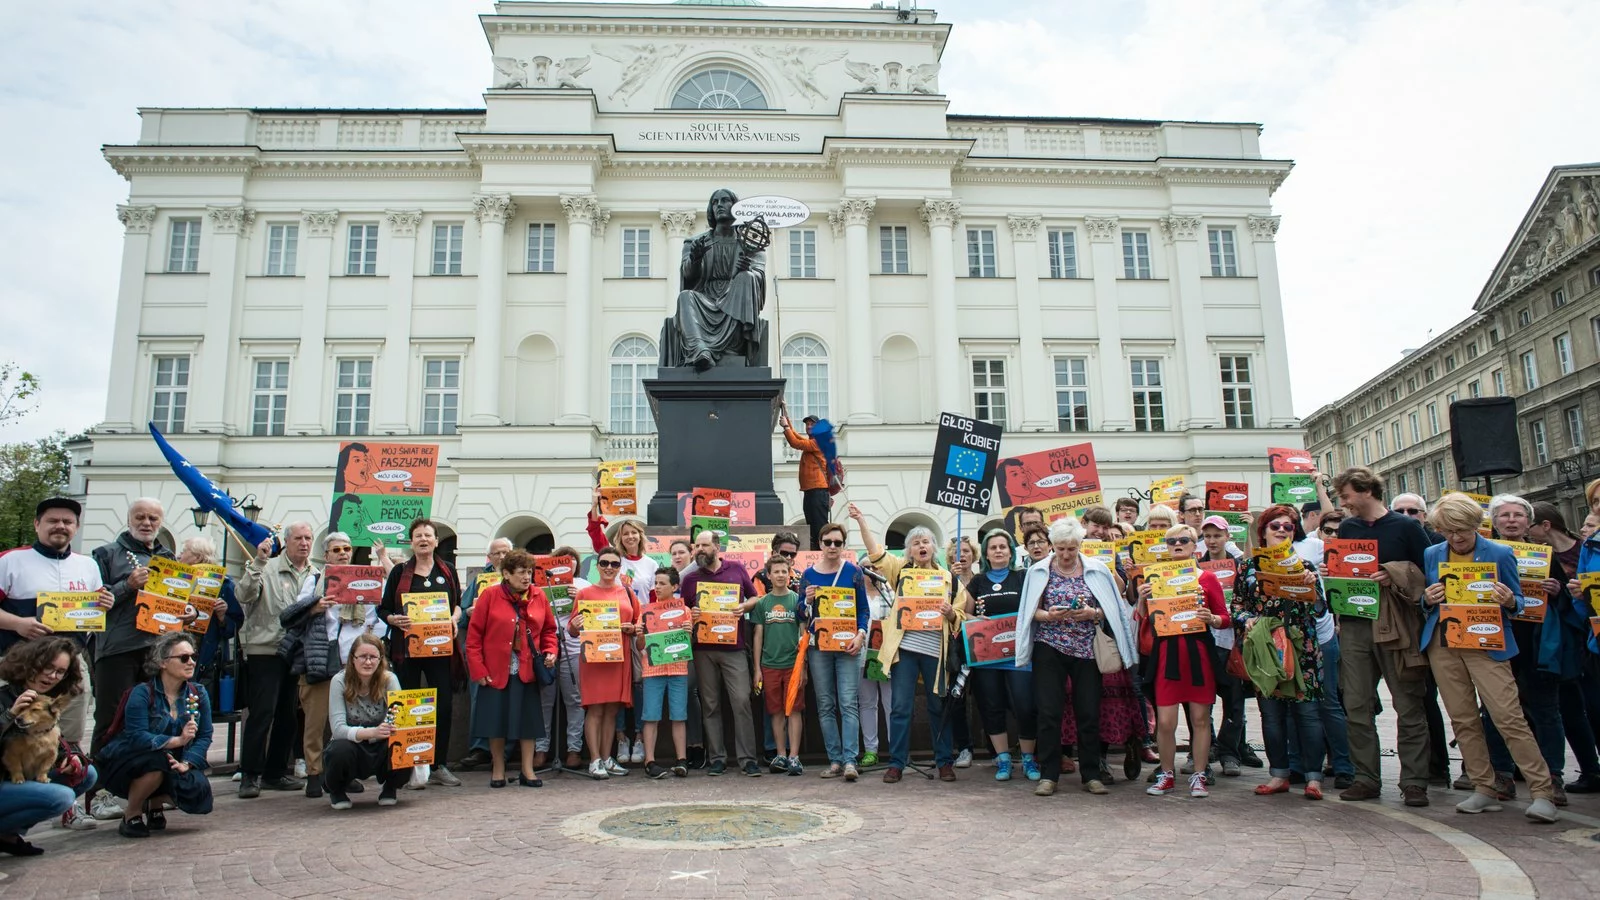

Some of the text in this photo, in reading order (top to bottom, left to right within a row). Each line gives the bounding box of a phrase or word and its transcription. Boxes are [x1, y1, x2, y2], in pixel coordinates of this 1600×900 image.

[690, 122, 749, 132] SOCIETAS
[638, 132, 800, 142] SCIENTIARVM VARSAVIENSIS
[941, 414, 974, 432] GŁOS
[963, 432, 999, 451] KOBIET
[382, 446, 396, 455] MÓJ
[399, 446, 419, 455] ŚWIAT
[1049, 449, 1070, 460] MOJE
[381, 458, 433, 468] FASZYZMU
[1050, 453, 1089, 473] CIAŁO
[730, 499, 750, 508] AŁO
[937, 490, 979, 509] KOBIET
[1052, 495, 1100, 512] PRZYJACIELE
[380, 508, 424, 520] PENSJA
[1350, 542, 1375, 551] CIAŁO
[1212, 561, 1233, 569] CIAŁO
[355, 568, 382, 578] CIAŁO
[663, 601, 683, 610] CIAŁO
[664, 635, 688, 645] PENSJA
